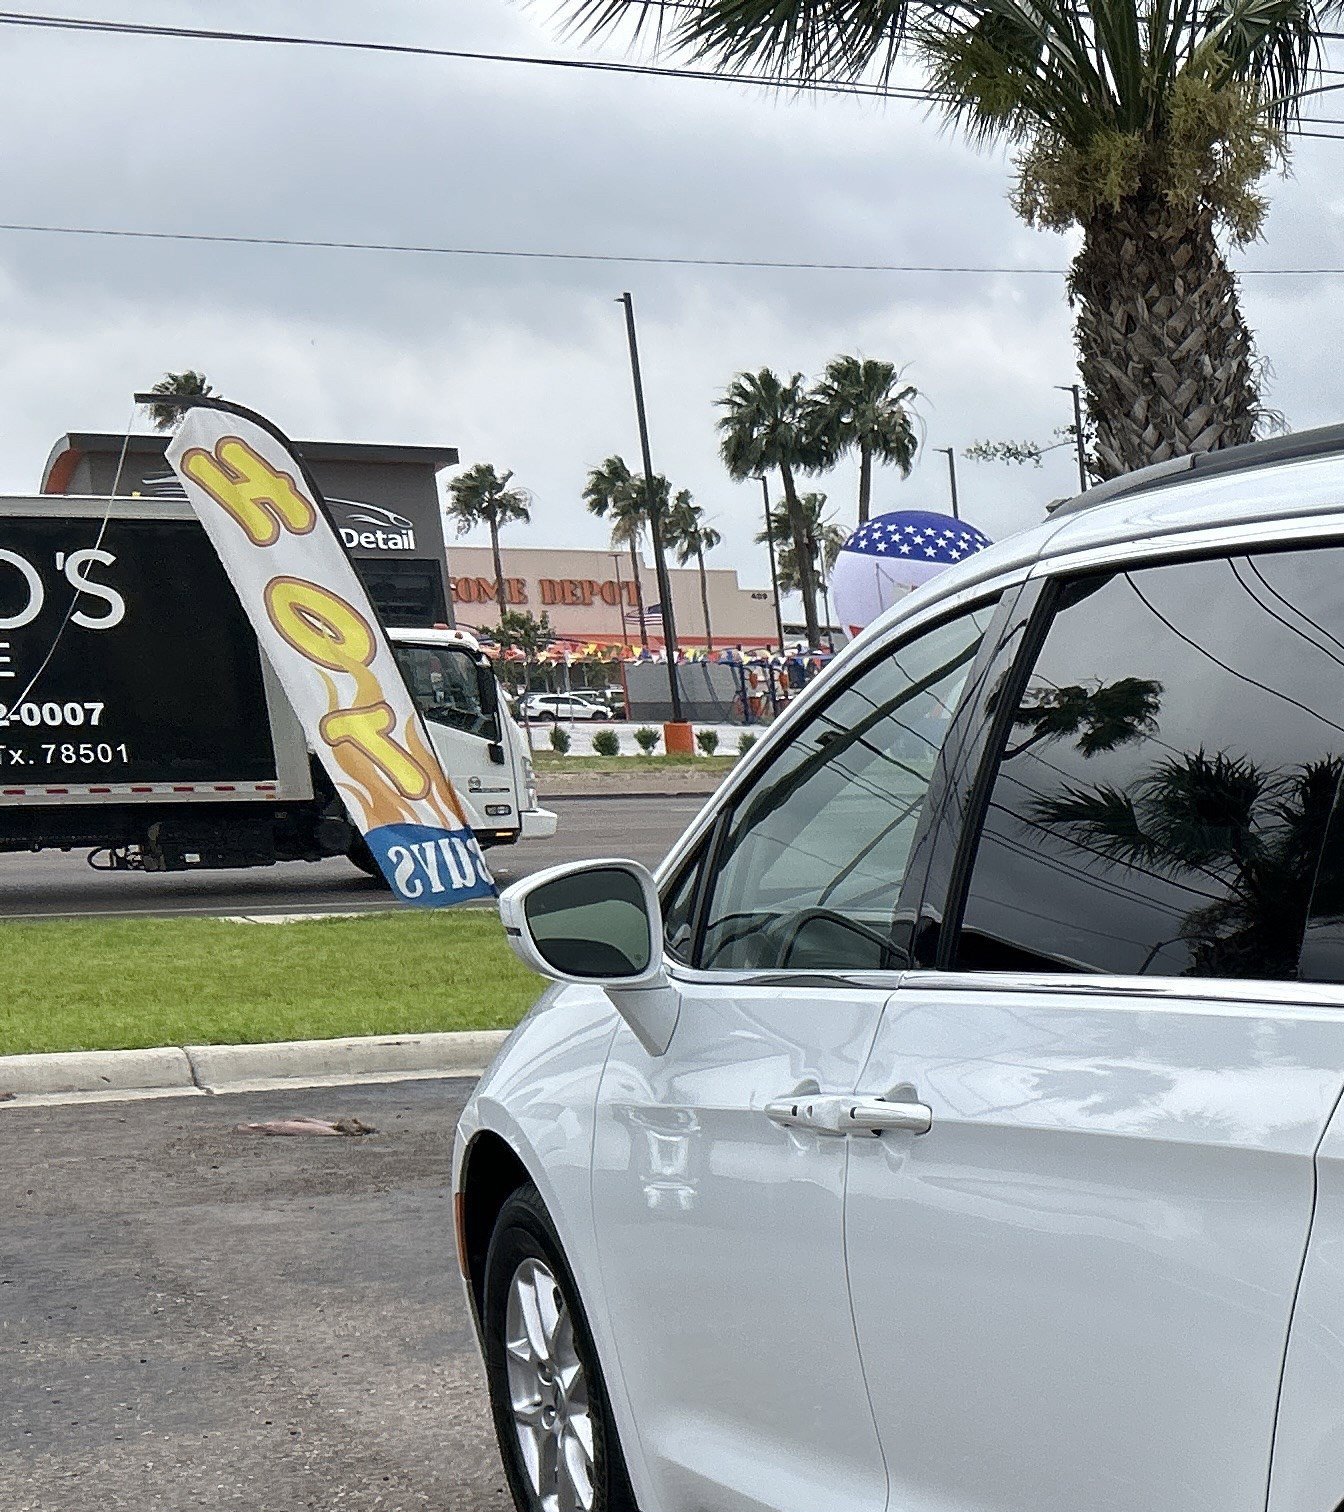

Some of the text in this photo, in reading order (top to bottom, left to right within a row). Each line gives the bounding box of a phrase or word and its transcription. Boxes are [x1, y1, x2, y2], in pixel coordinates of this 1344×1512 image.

[339, 527, 415, 550] Detail
[539, 578, 640, 606] DEPOT
[180, 435, 432, 801] HOT
[41, 743, 128, 764] 78501
